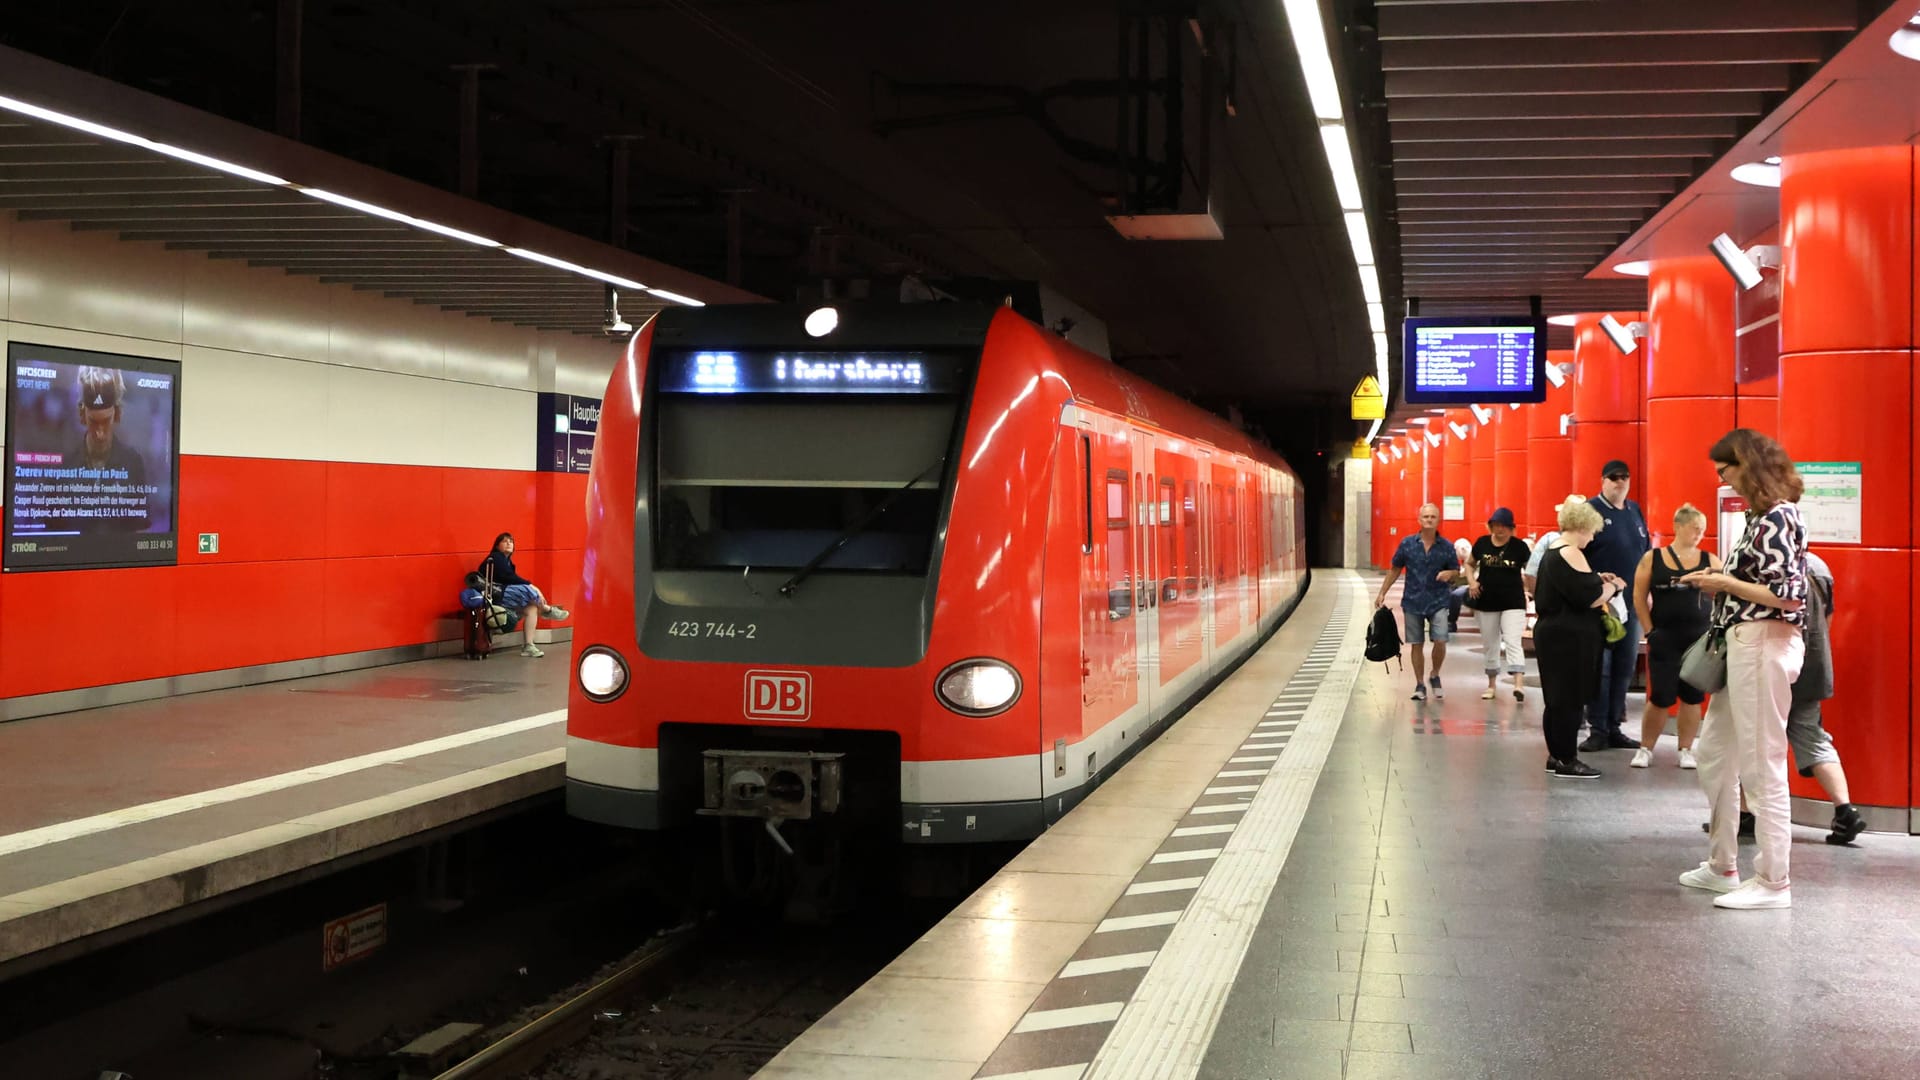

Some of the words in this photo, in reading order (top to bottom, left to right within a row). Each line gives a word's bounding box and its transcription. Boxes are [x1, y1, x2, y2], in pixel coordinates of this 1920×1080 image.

[15, 466, 43, 477] Zverev
[44, 467, 78, 480] verpasst
[79, 467, 101, 479] Finale
[102, 467, 110, 479] in
[110, 467, 129, 479] Paris
[52, 508, 60, 517] der
[61, 508, 76, 517] Carlos
[11, 542, 37, 553] STRÖER
[668, 622, 700, 637] 423
[705, 623, 757, 639] 744-2
[754, 679, 802, 711] DB
